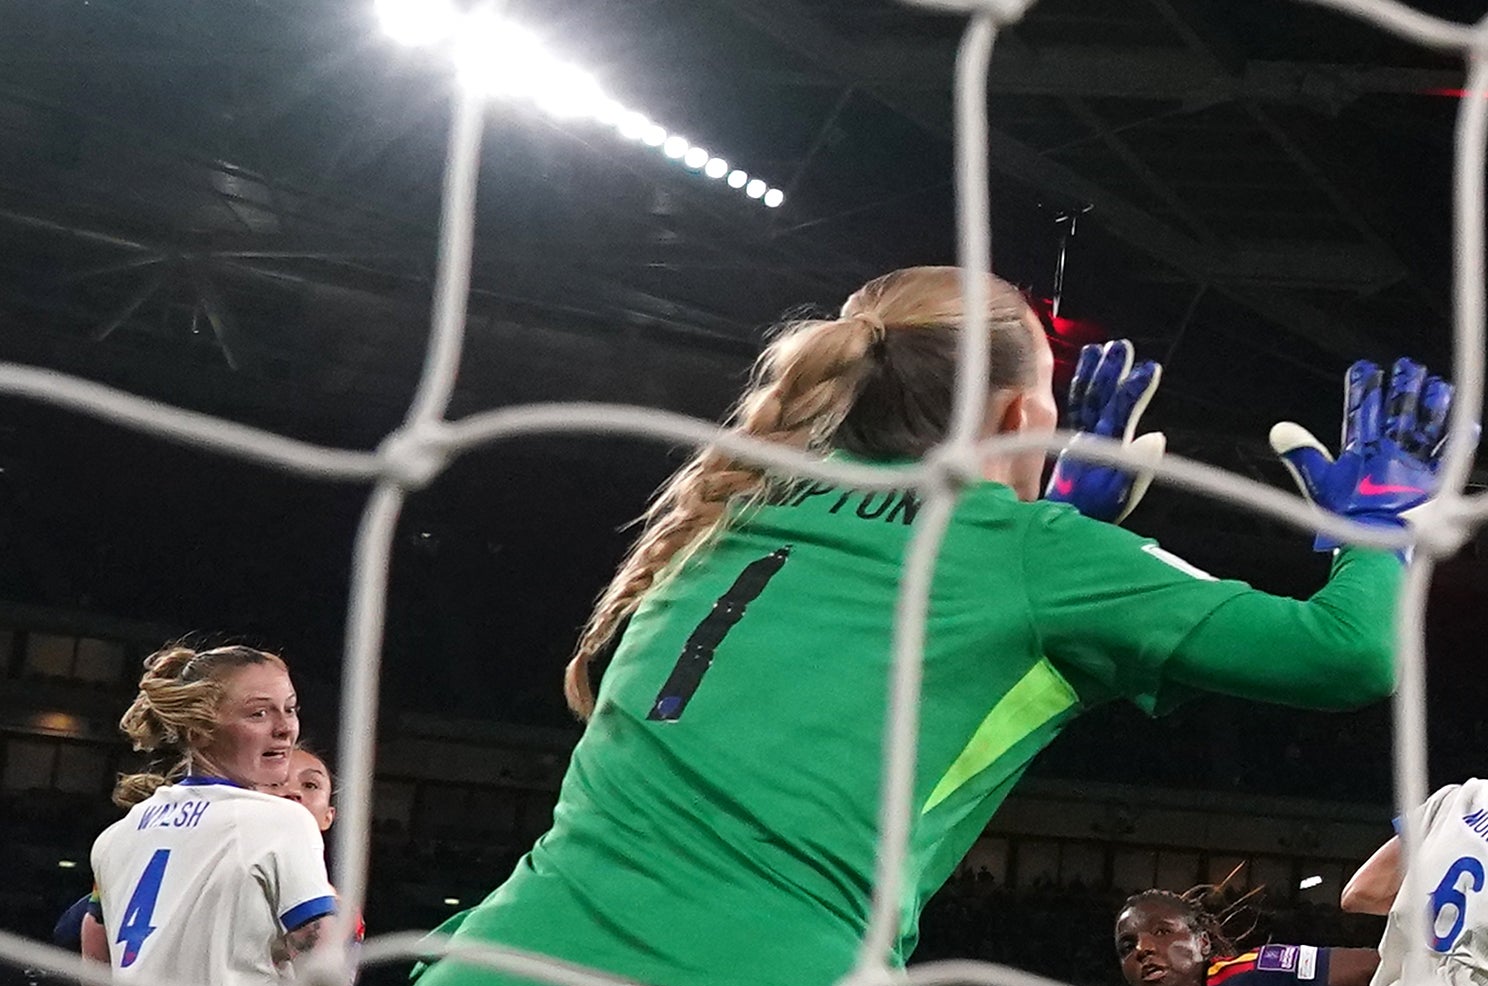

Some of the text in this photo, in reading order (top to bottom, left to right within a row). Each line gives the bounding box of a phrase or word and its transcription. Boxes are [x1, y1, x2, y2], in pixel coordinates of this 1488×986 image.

[646, 544, 792, 722] 1
[115, 849, 172, 968] 4
[1428, 856, 1486, 953] 6
